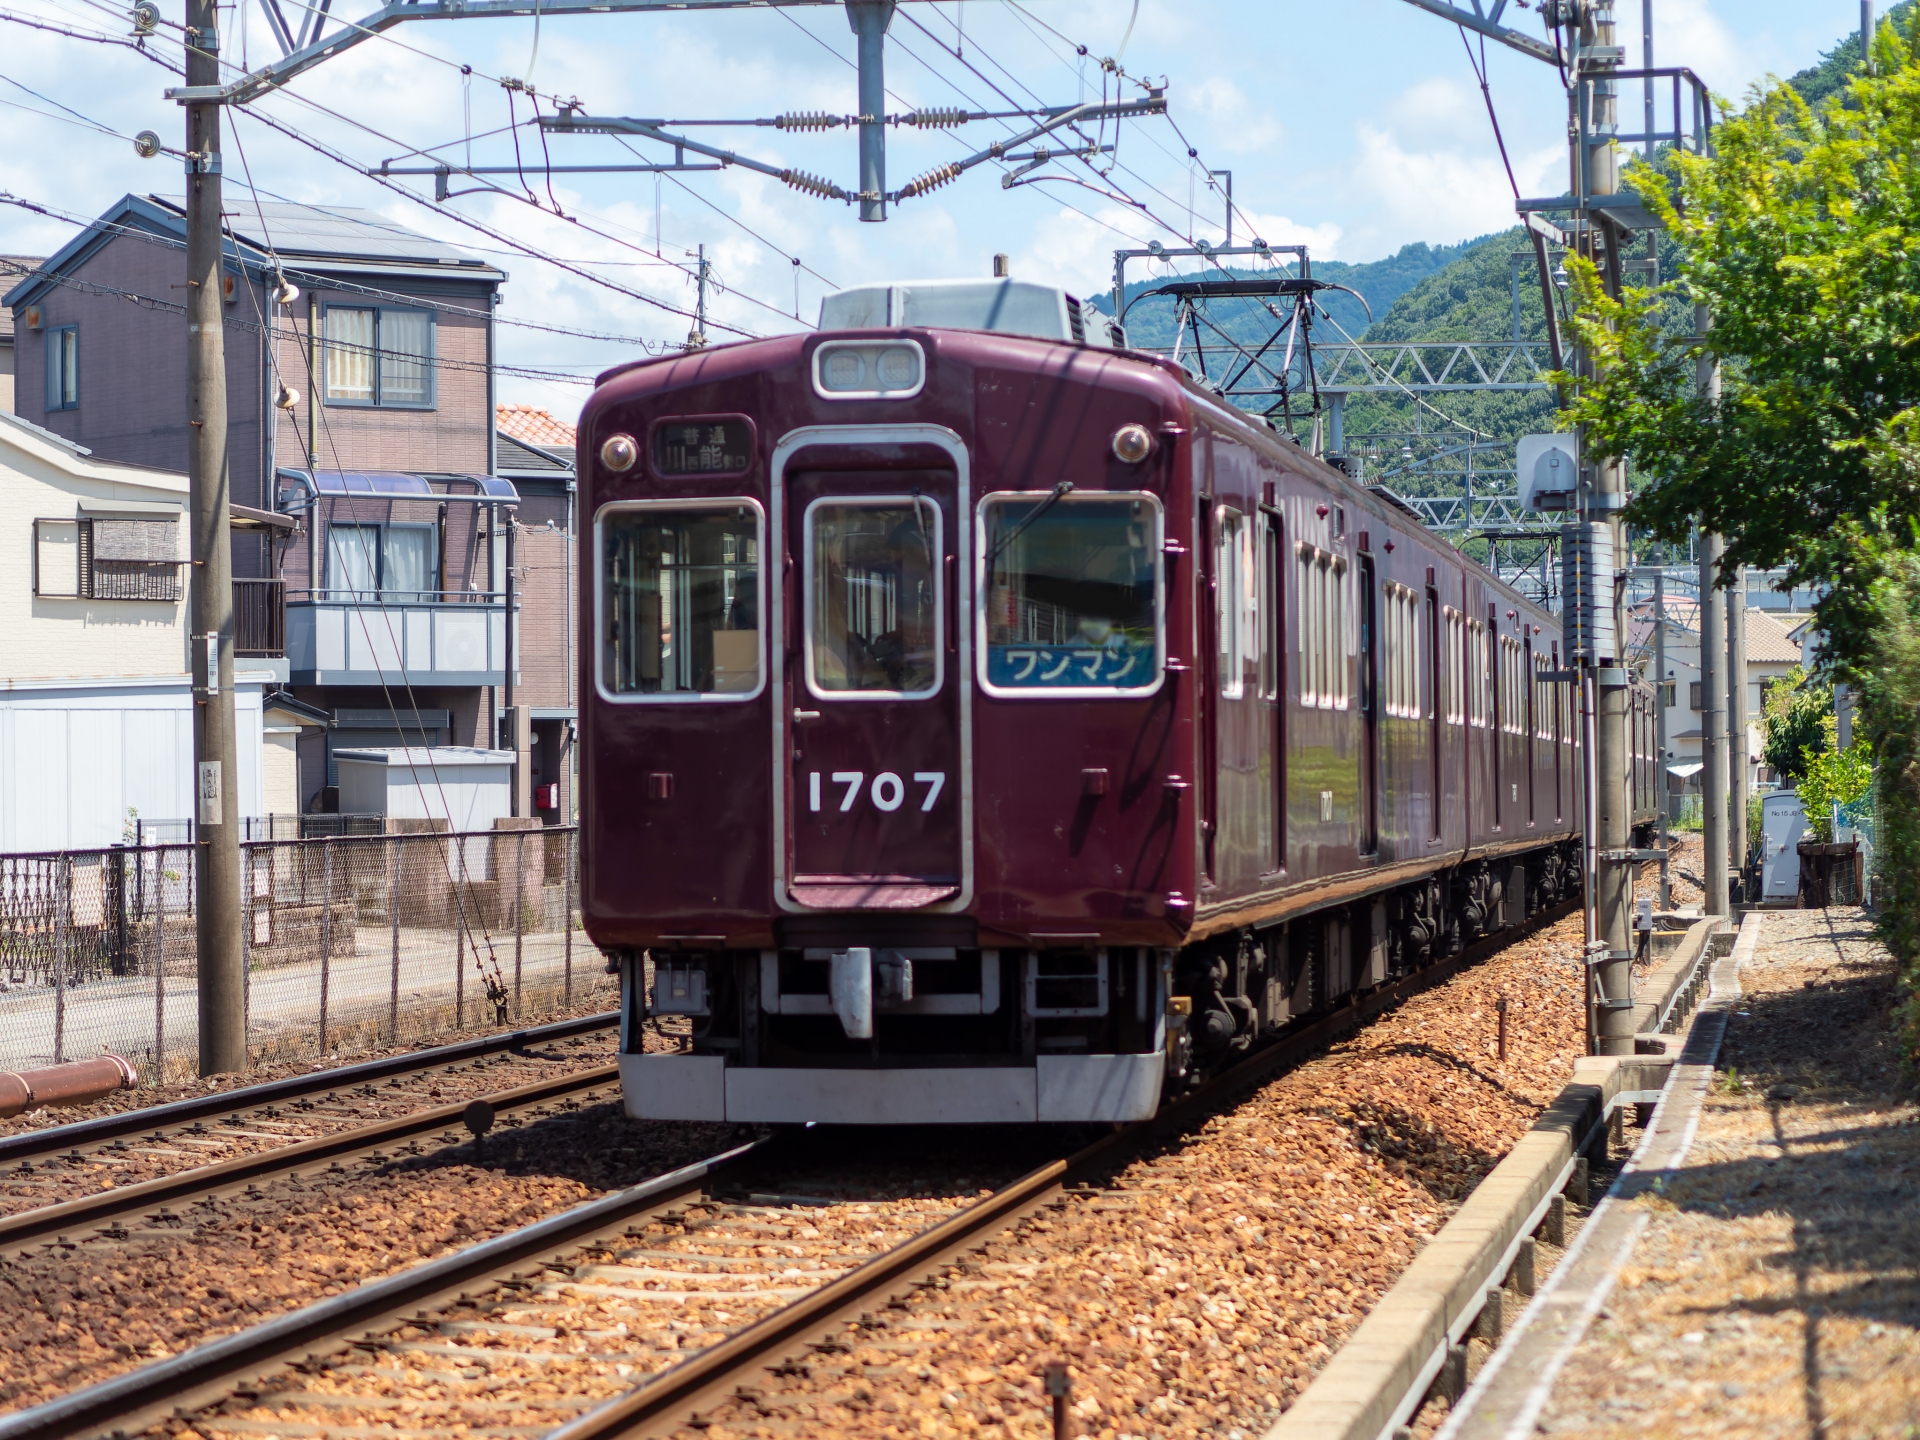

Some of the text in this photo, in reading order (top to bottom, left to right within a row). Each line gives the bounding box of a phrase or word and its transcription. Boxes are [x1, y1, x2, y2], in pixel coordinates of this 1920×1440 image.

[1006, 650, 1137, 681] ワンマン
[809, 771, 946, 812] 1707
